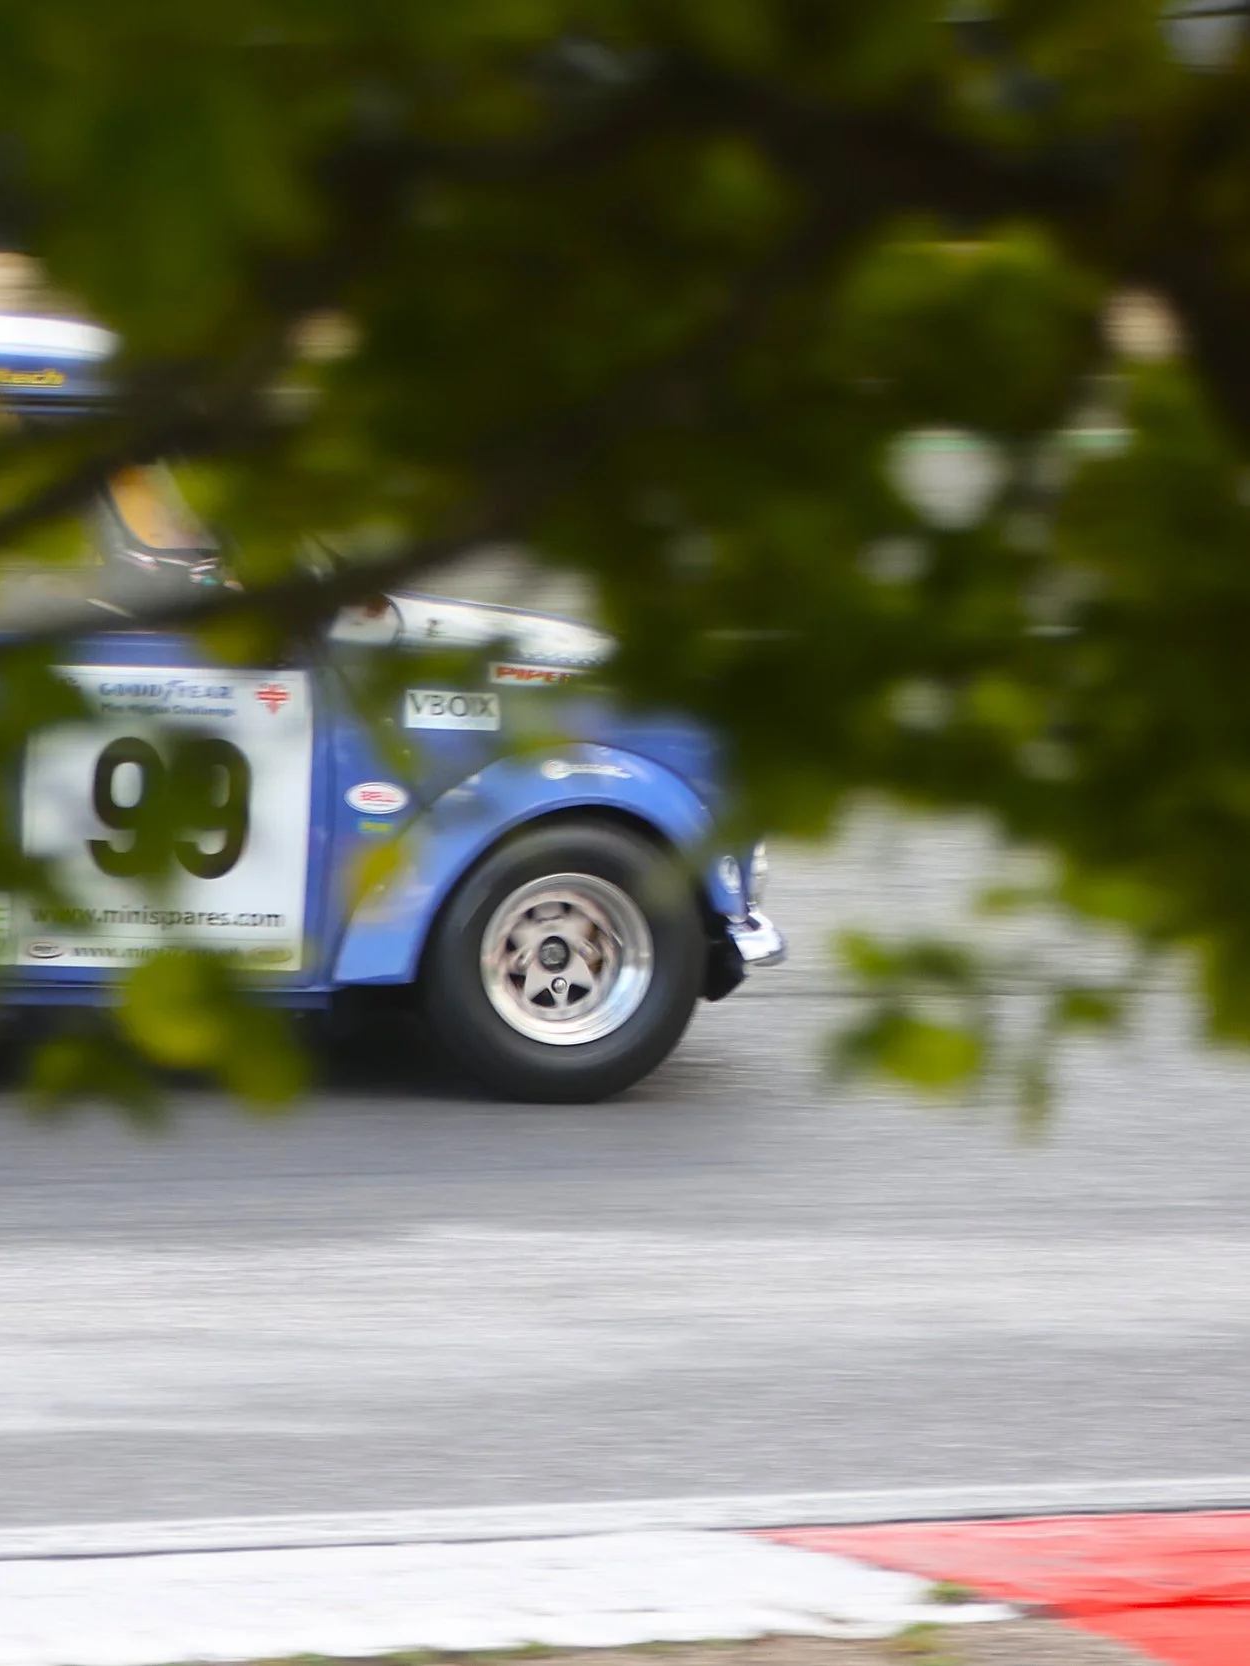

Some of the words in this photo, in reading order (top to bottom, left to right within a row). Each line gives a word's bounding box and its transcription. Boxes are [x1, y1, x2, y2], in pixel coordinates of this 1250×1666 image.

[99, 680, 235, 700] GOODYEAR
[86, 736, 251, 879] 99
[31, 904, 286, 930] www.minispares.com
